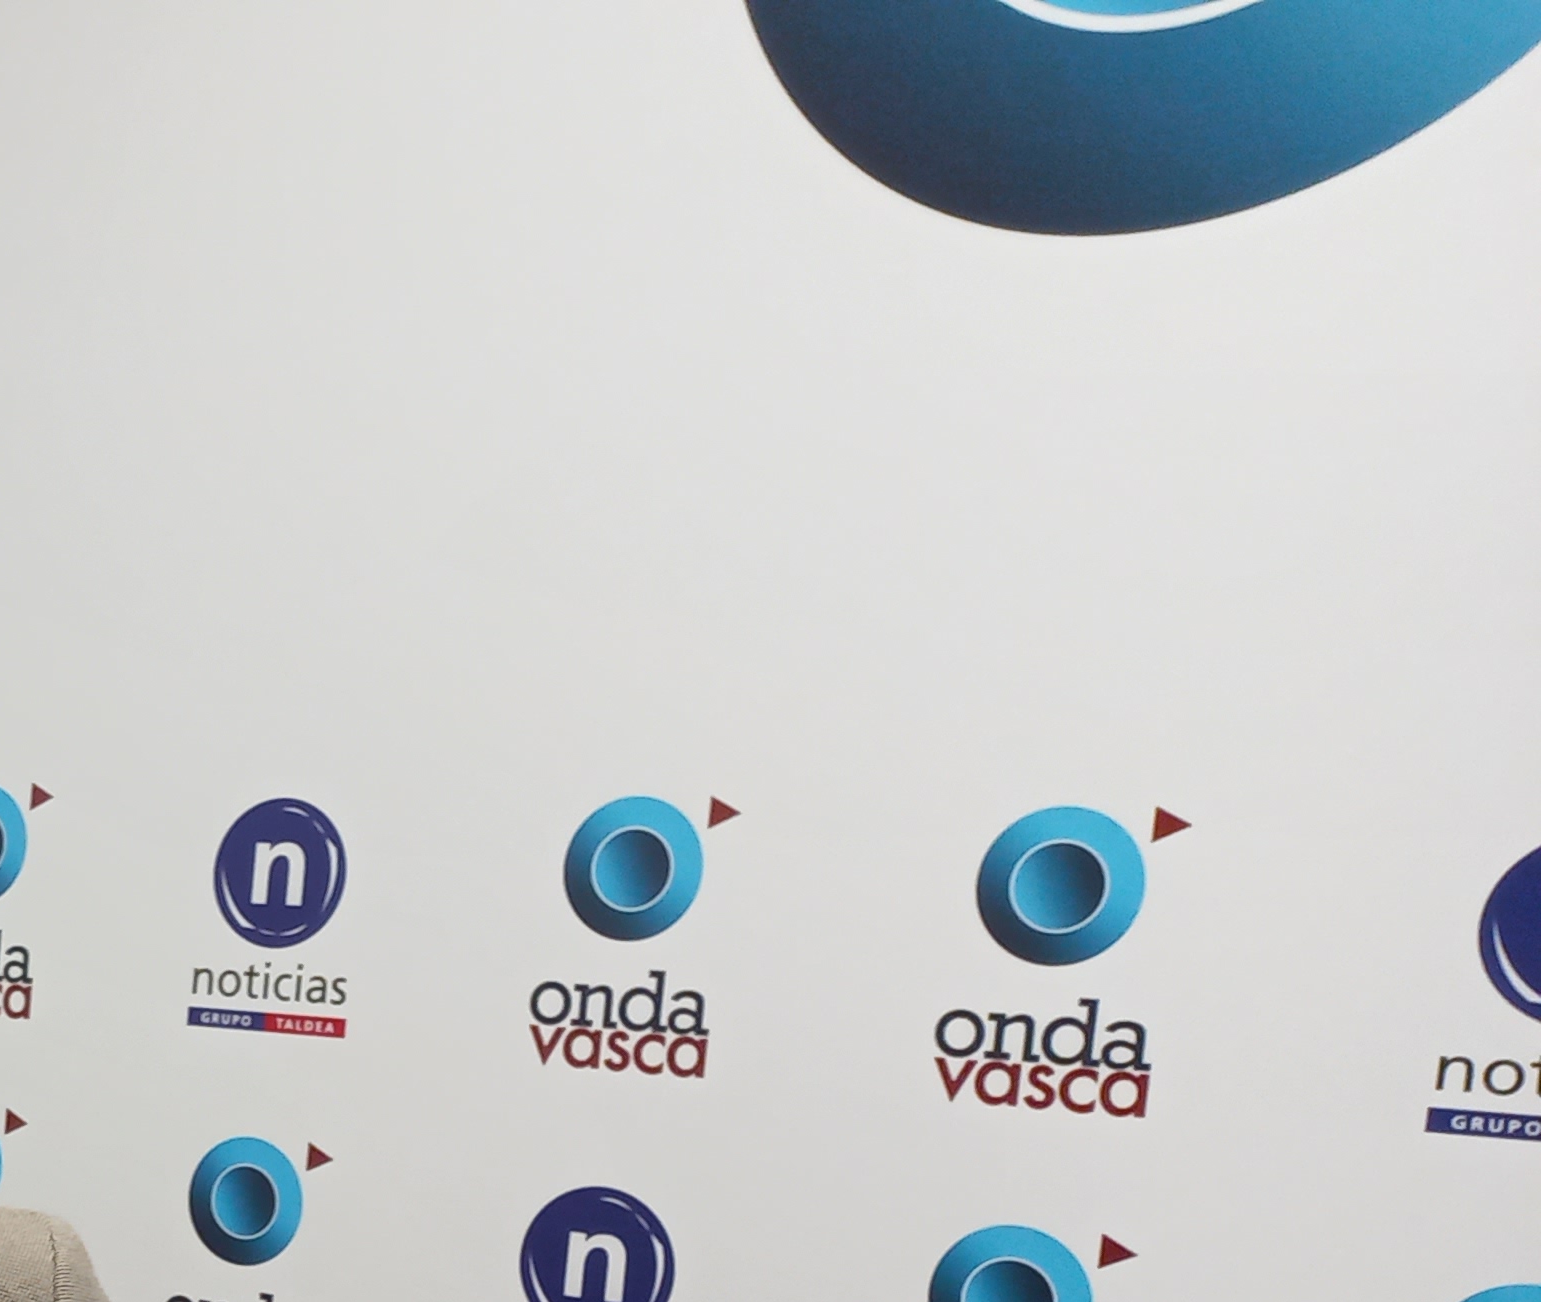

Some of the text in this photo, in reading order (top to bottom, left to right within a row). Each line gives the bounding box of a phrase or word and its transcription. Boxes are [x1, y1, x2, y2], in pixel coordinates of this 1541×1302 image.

[252, 838, 307, 908] n
[189, 962, 348, 1007] noticias
[528, 970, 710, 1037] onda
[198, 1009, 337, 1036] GRUPO TALDEA
[528, 1023, 709, 1079] vasca
[933, 998, 1152, 1072] onda
[933, 1055, 1150, 1119] vasca
[1450, 1114, 1541, 1137] GRUPO
